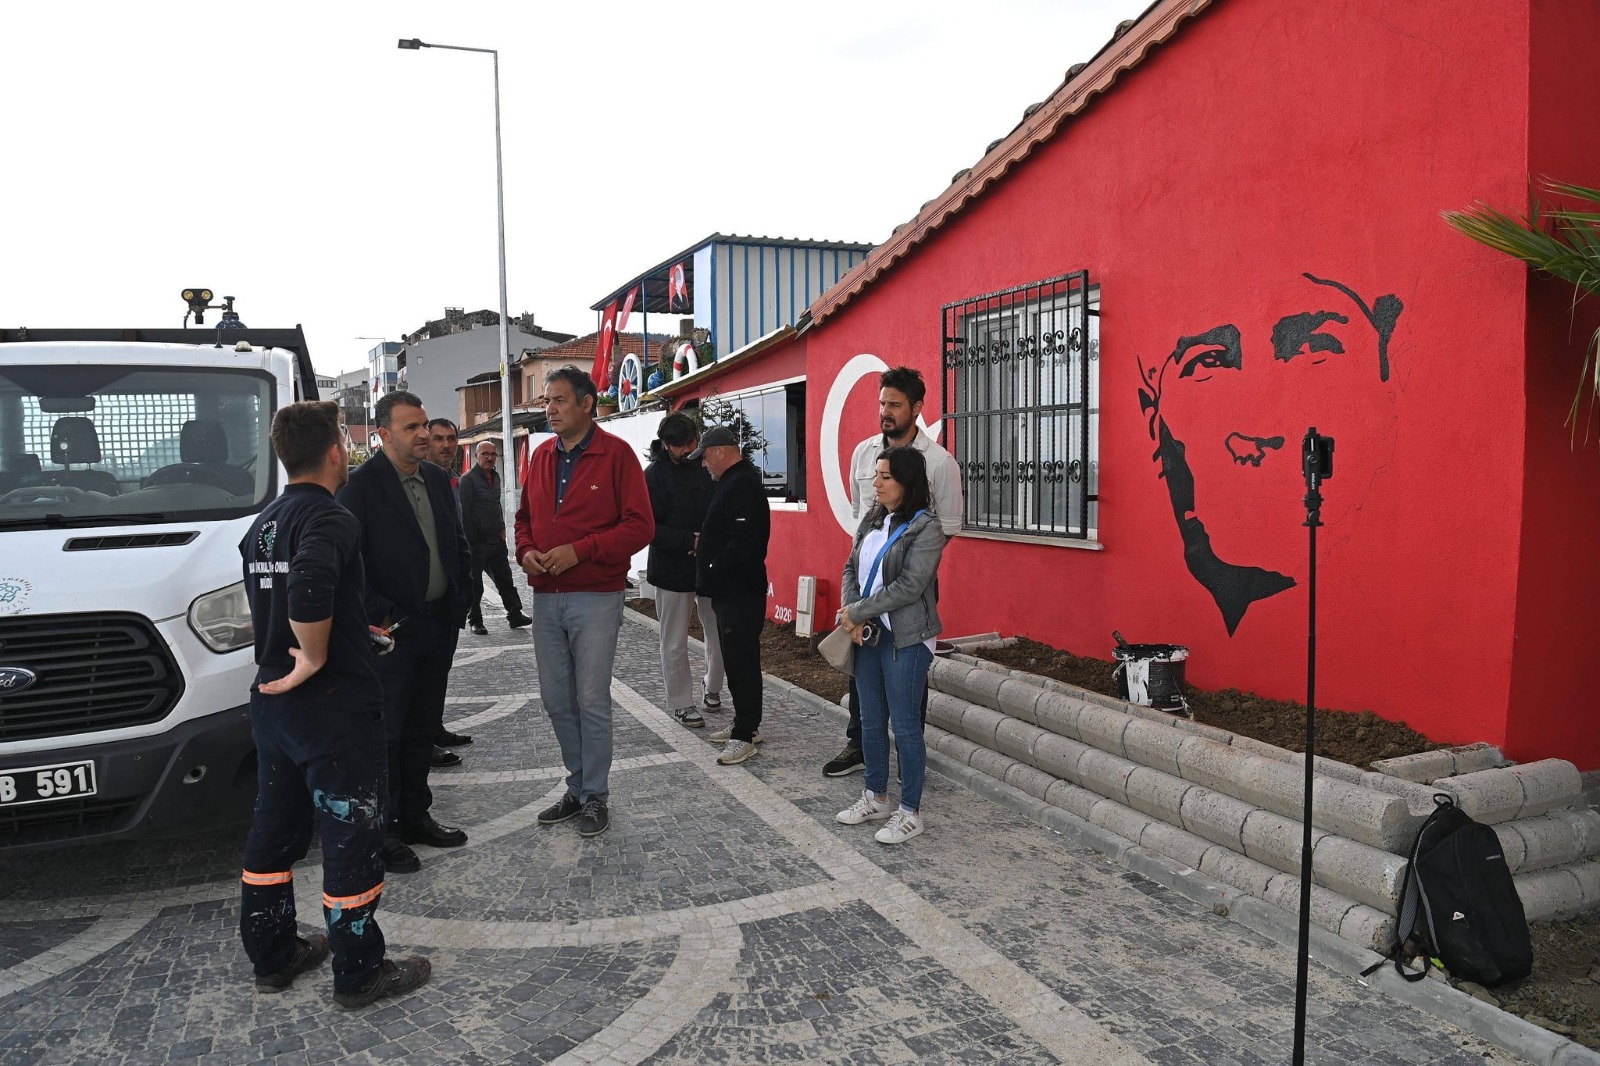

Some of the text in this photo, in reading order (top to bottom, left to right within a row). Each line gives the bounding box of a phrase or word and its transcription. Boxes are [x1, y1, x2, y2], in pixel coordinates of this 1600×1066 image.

[767, 582, 774, 597] A
[774, 604, 792, 623] 2026
[36, 766, 88, 797] 591
